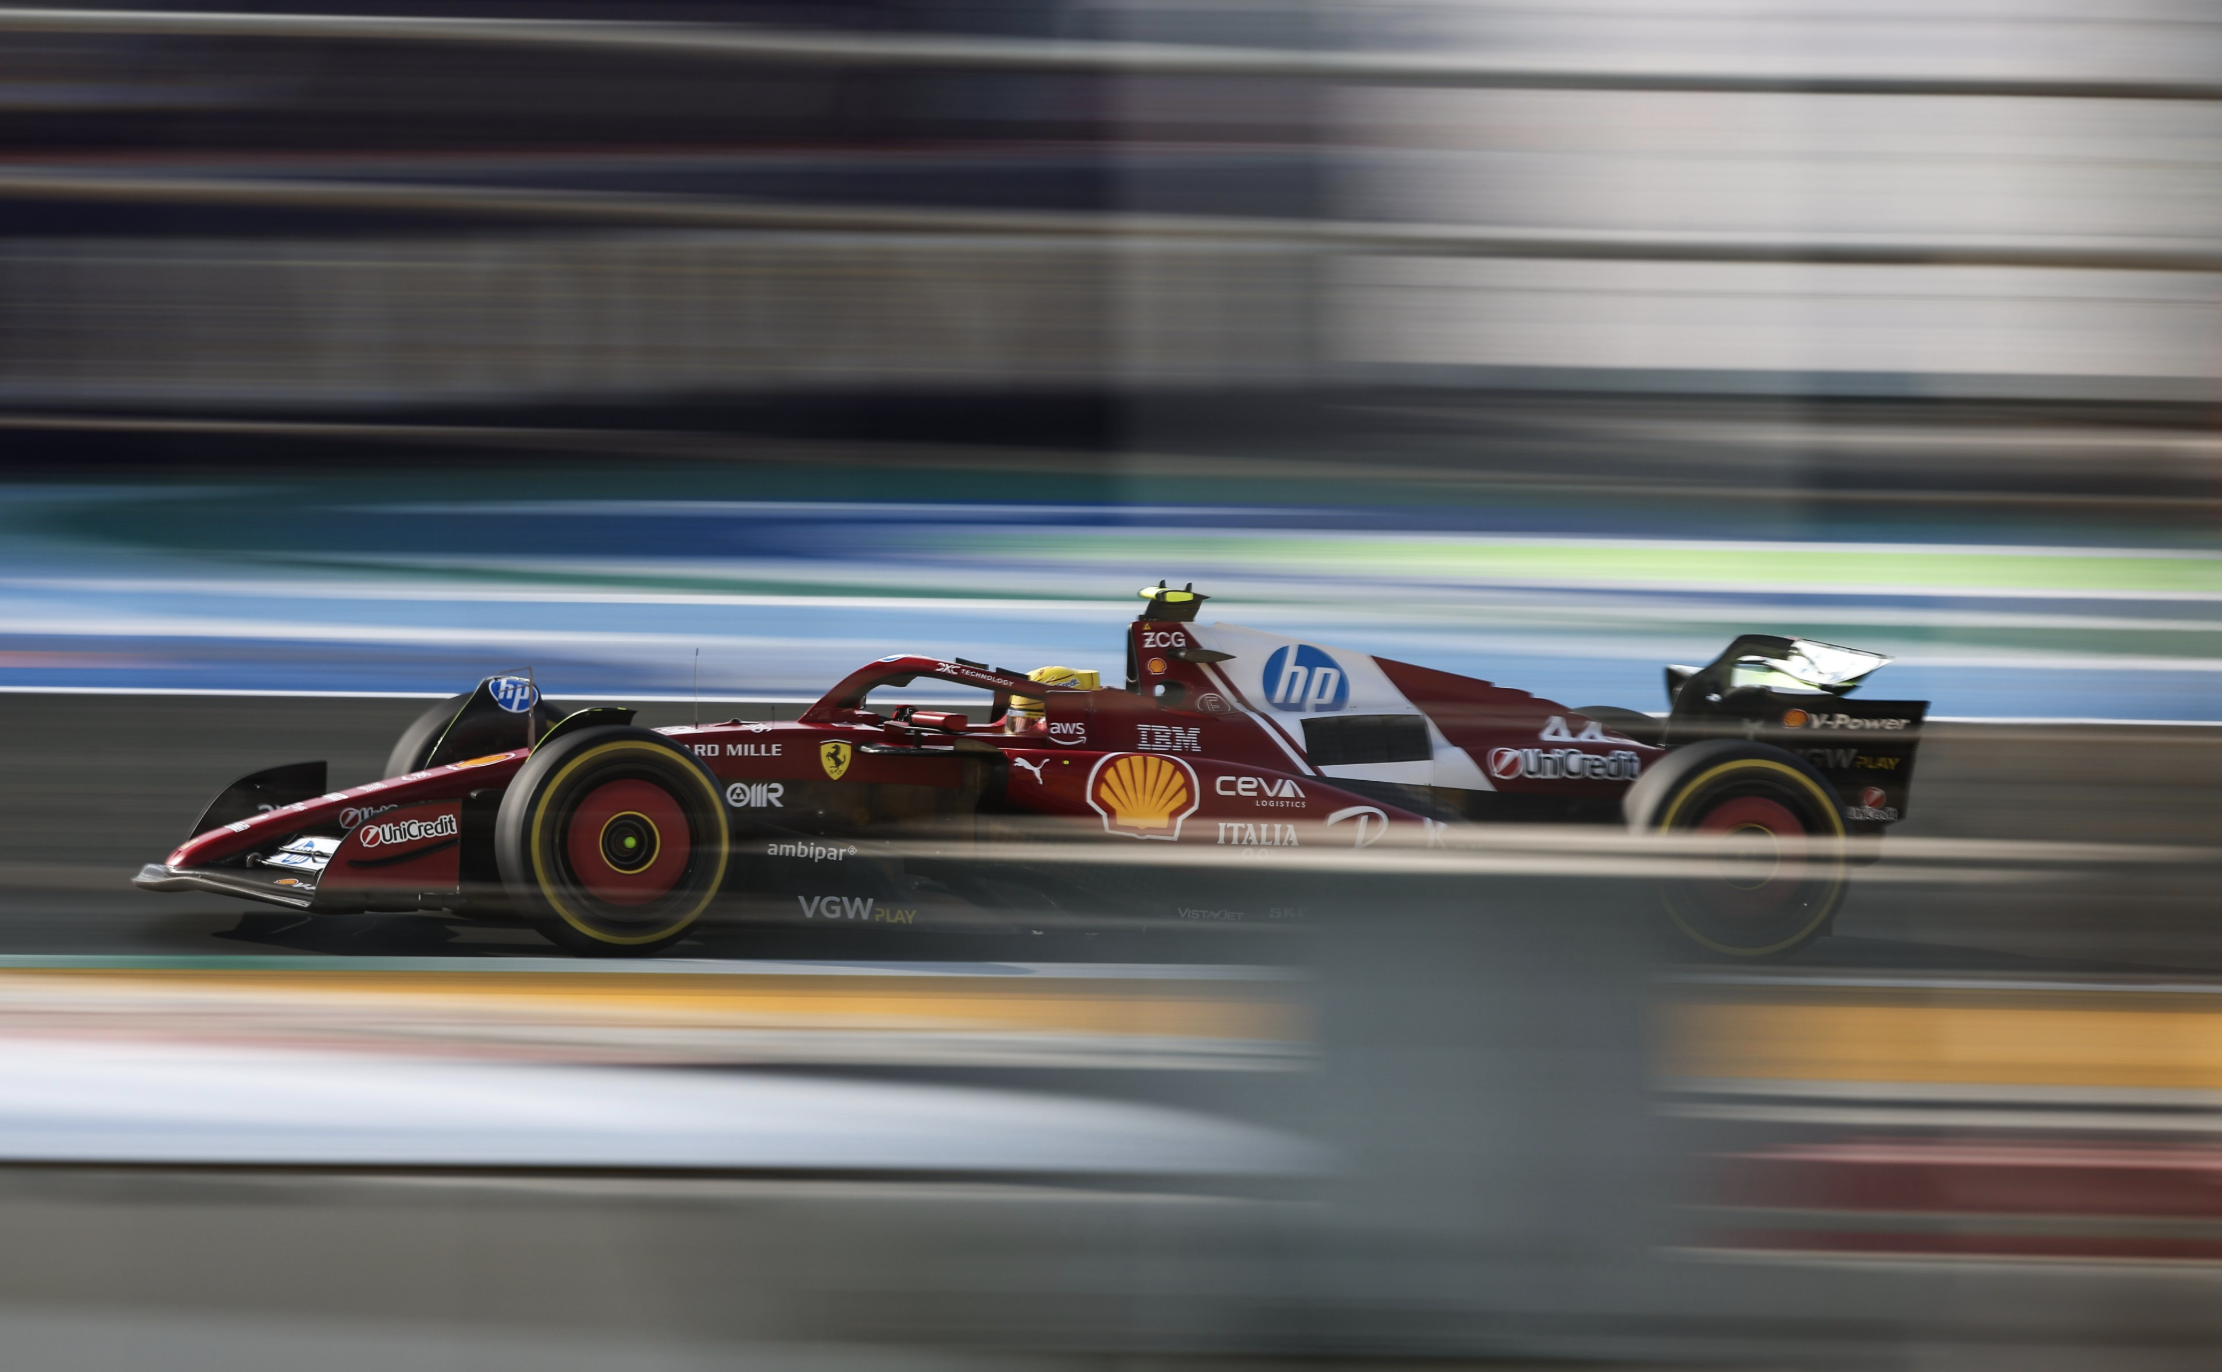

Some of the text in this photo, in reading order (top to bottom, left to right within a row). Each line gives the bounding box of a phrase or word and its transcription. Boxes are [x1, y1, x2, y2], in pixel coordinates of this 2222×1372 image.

[961, 668, 1015, 688] TECHNOLOGY
[1274, 644, 1341, 712] hp
[1050, 722, 1086, 735] aws
[1809, 713, 1911, 731] V-Power
[1137, 724, 1202, 752] IBM
[685, 743, 783, 757] RD MILLE
[1521, 748, 1642, 781] UniCredit
[1854, 756, 1902, 770] PLAY
[1256, 800, 1306, 809] LOGISTICS
[380, 814, 458, 845] UniCredit
[1217, 822, 1300, 847] ITALIA
[767, 842, 847, 863] ambipar
[798, 896, 917, 924] VGW PLAY
